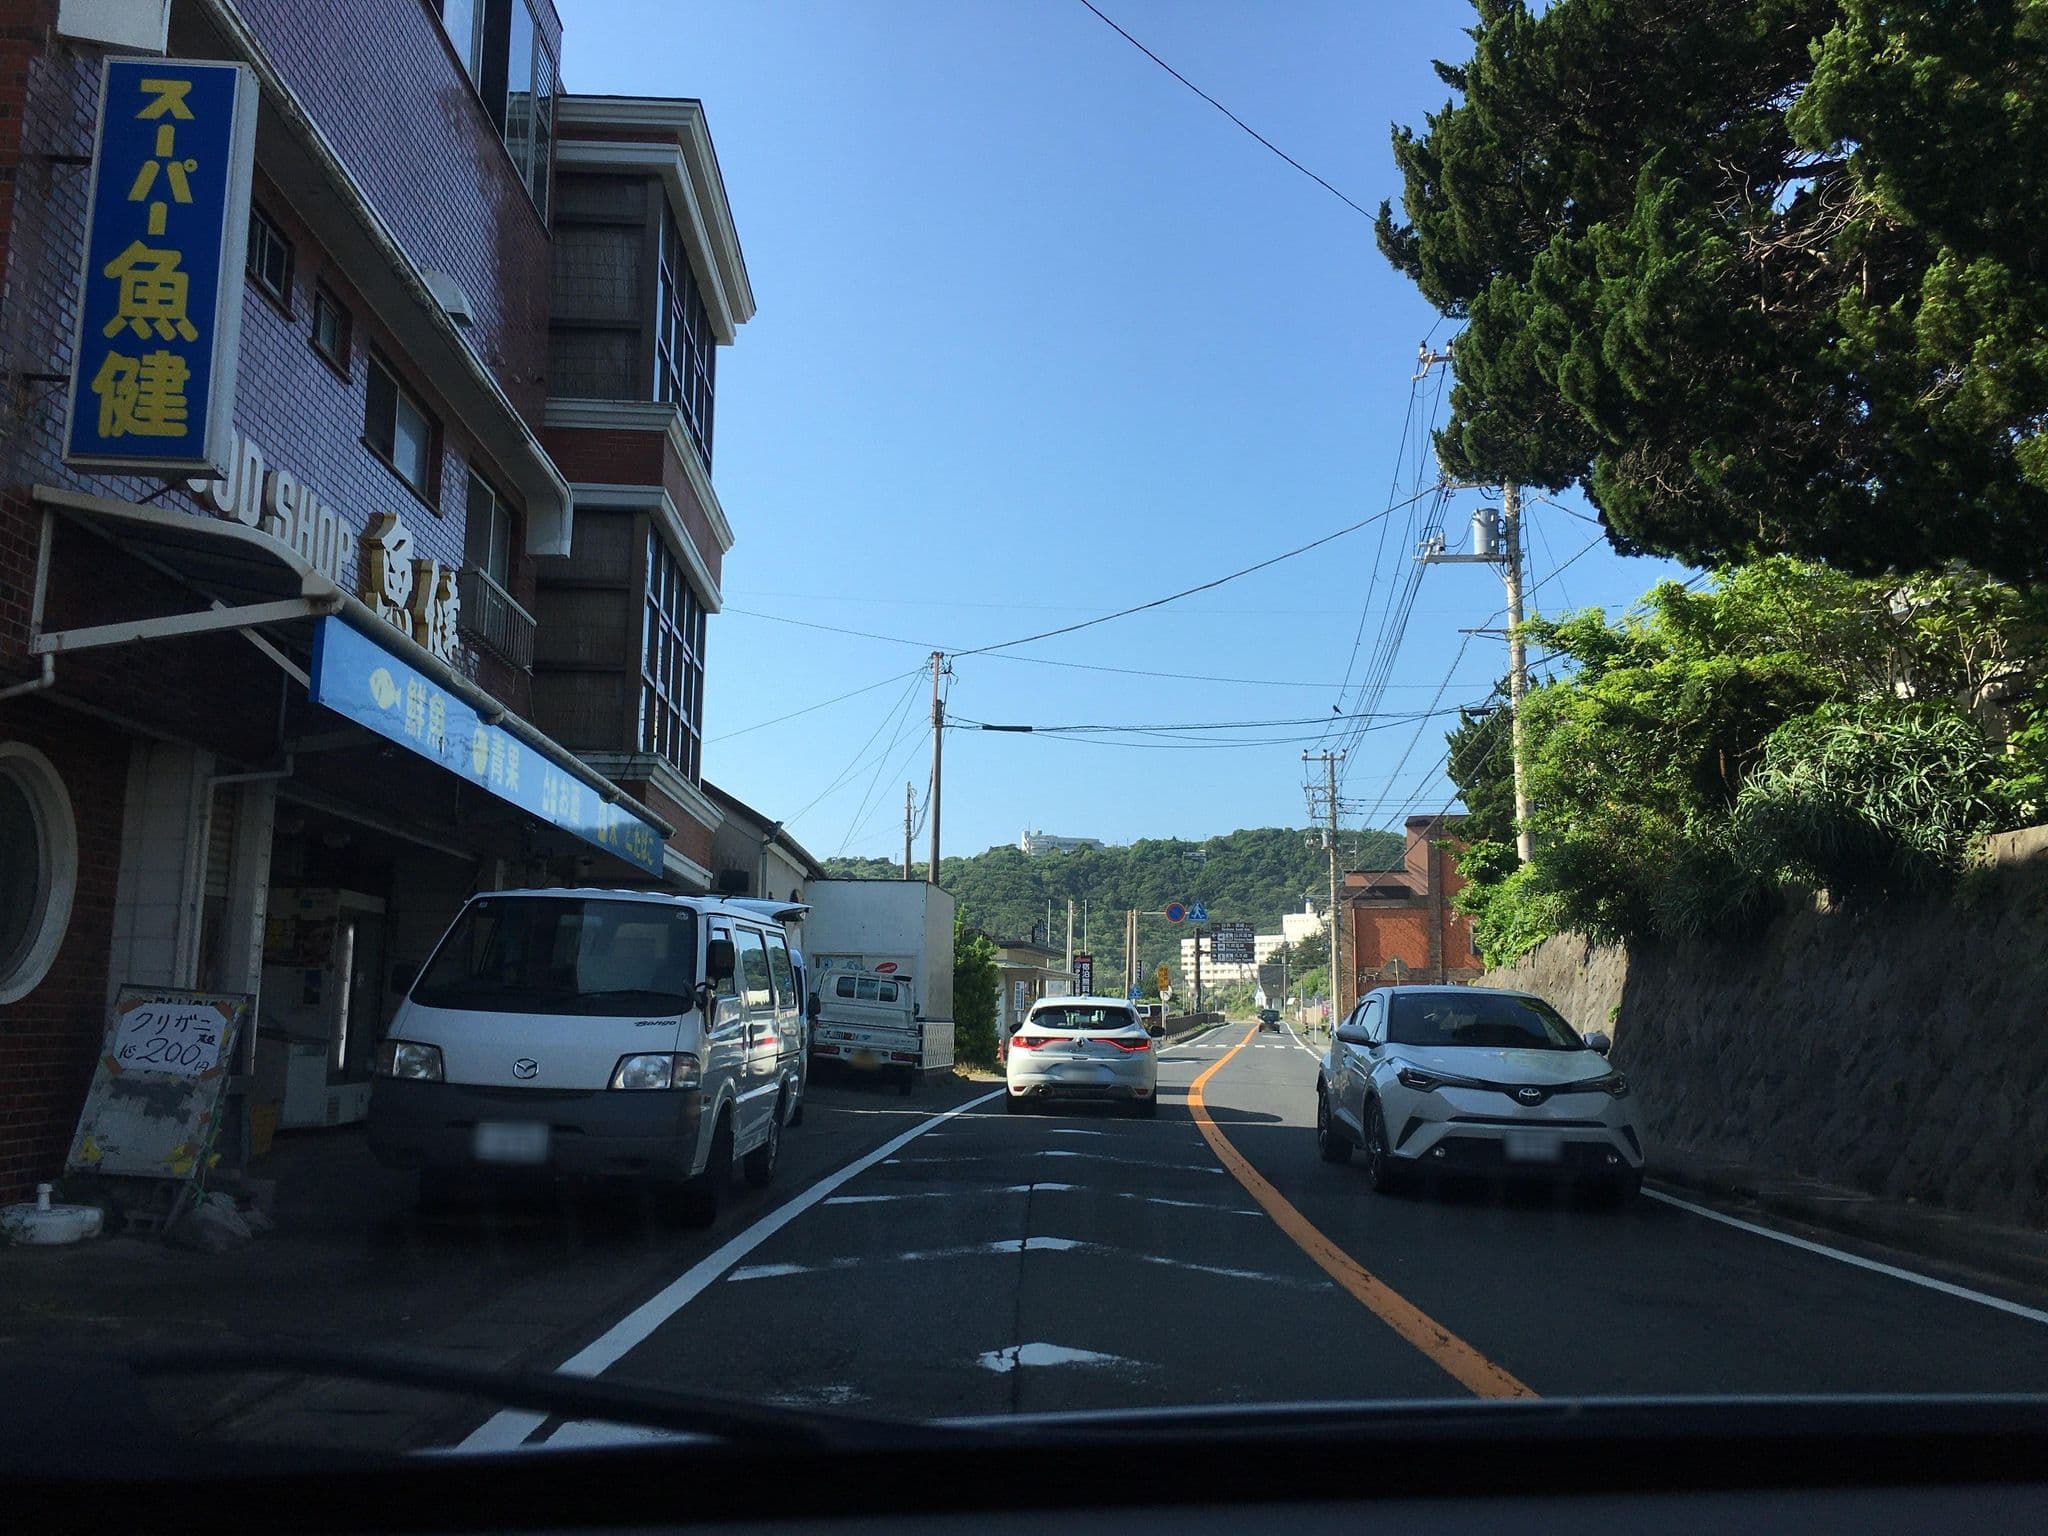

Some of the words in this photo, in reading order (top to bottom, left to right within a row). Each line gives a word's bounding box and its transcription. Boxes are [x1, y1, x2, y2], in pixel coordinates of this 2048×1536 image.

[89, 77, 199, 440] スーパー魚健
[271, 469, 353, 584] SHOP
[130, 1012, 211, 1036] クリガニ
[634, 1020, 678, 1028] Bongo
